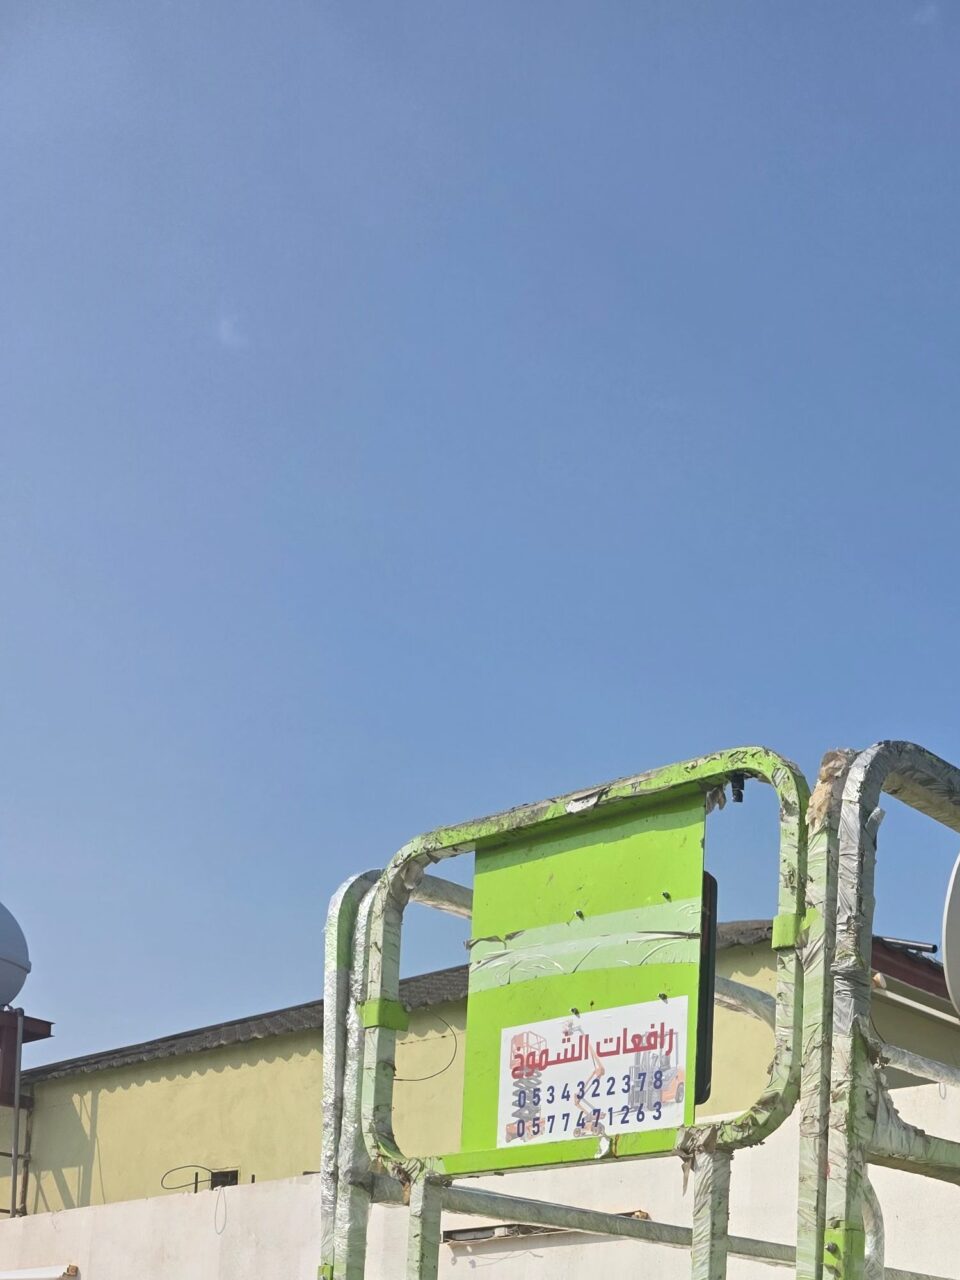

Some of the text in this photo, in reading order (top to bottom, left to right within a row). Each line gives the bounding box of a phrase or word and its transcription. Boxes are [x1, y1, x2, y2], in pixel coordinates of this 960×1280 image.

[511, 1022, 674, 1080] رافعات الشموخ
[517, 1070, 664, 1109] 0534322378
[516, 1101, 663, 1138] 0577471263
